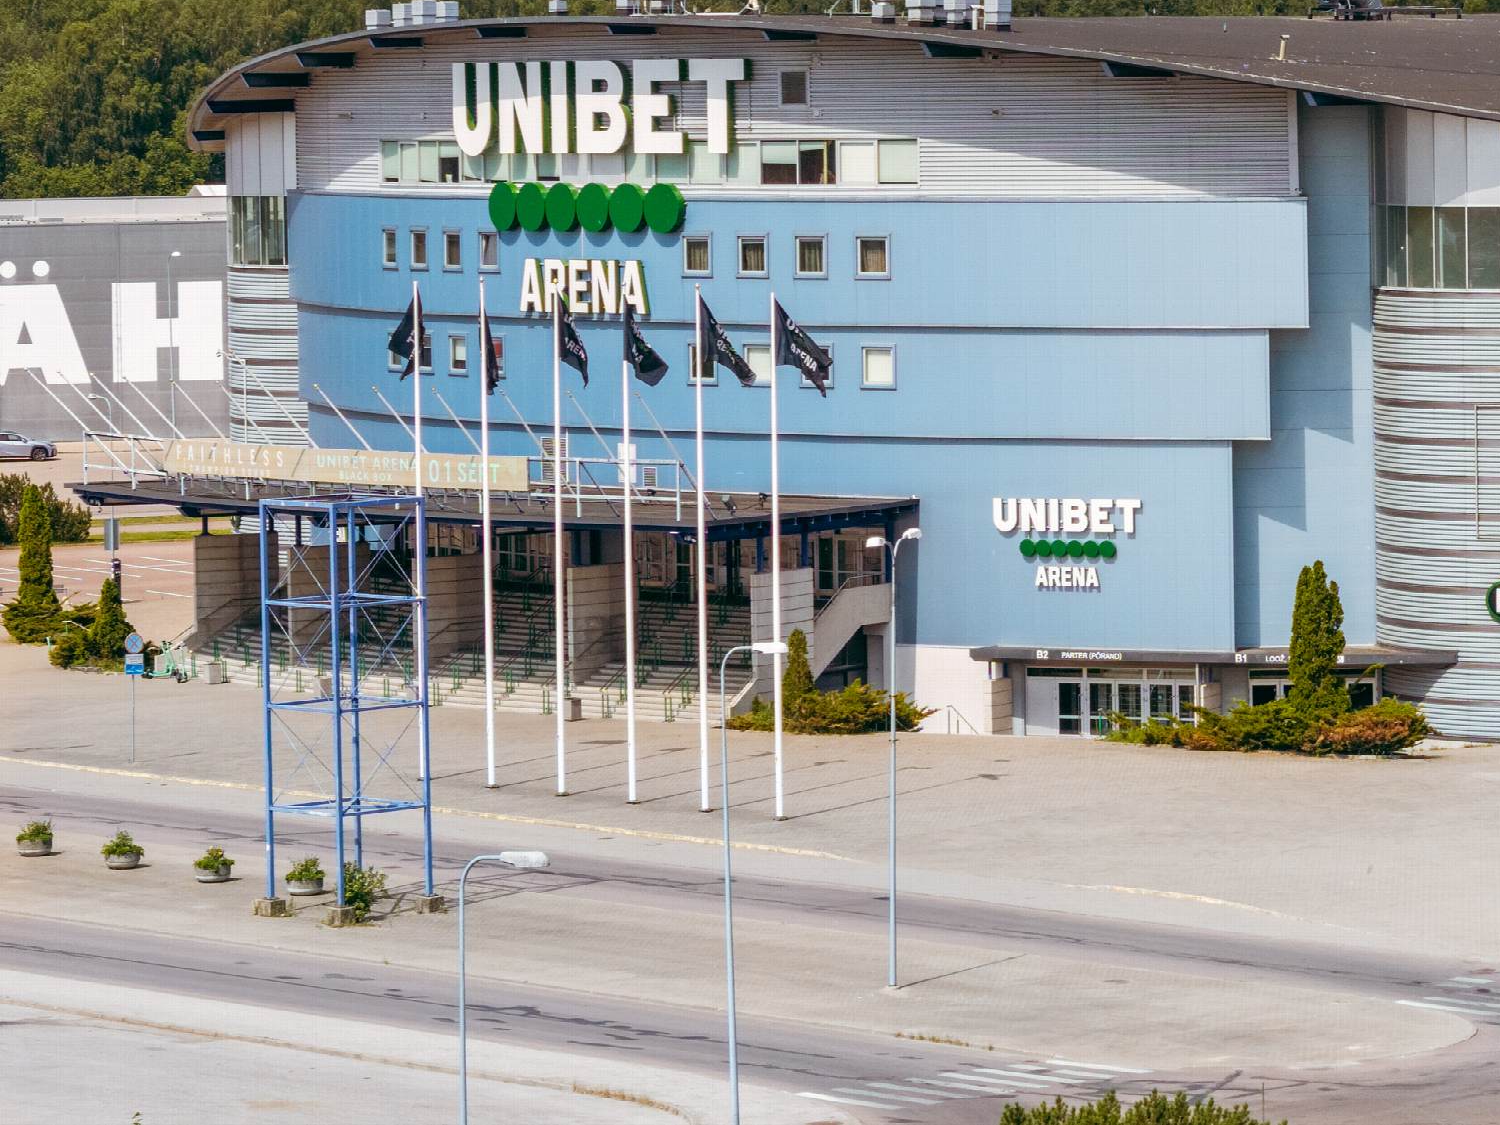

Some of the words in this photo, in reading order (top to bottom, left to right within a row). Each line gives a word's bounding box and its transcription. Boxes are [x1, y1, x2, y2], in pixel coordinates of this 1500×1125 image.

[452, 58, 747, 157] UNIBET
[520, 258, 648, 314] ARENA
[176, 444, 284, 468] FAITHLESS
[428, 459, 451, 483] 01
[992, 497, 1142, 533] UNIBET
[1035, 565, 1100, 587] ARENA
[1036, 649, 1049, 660] B2
[1061, 651, 1088, 659] PARTER
[1234, 653, 1248, 664] B1
